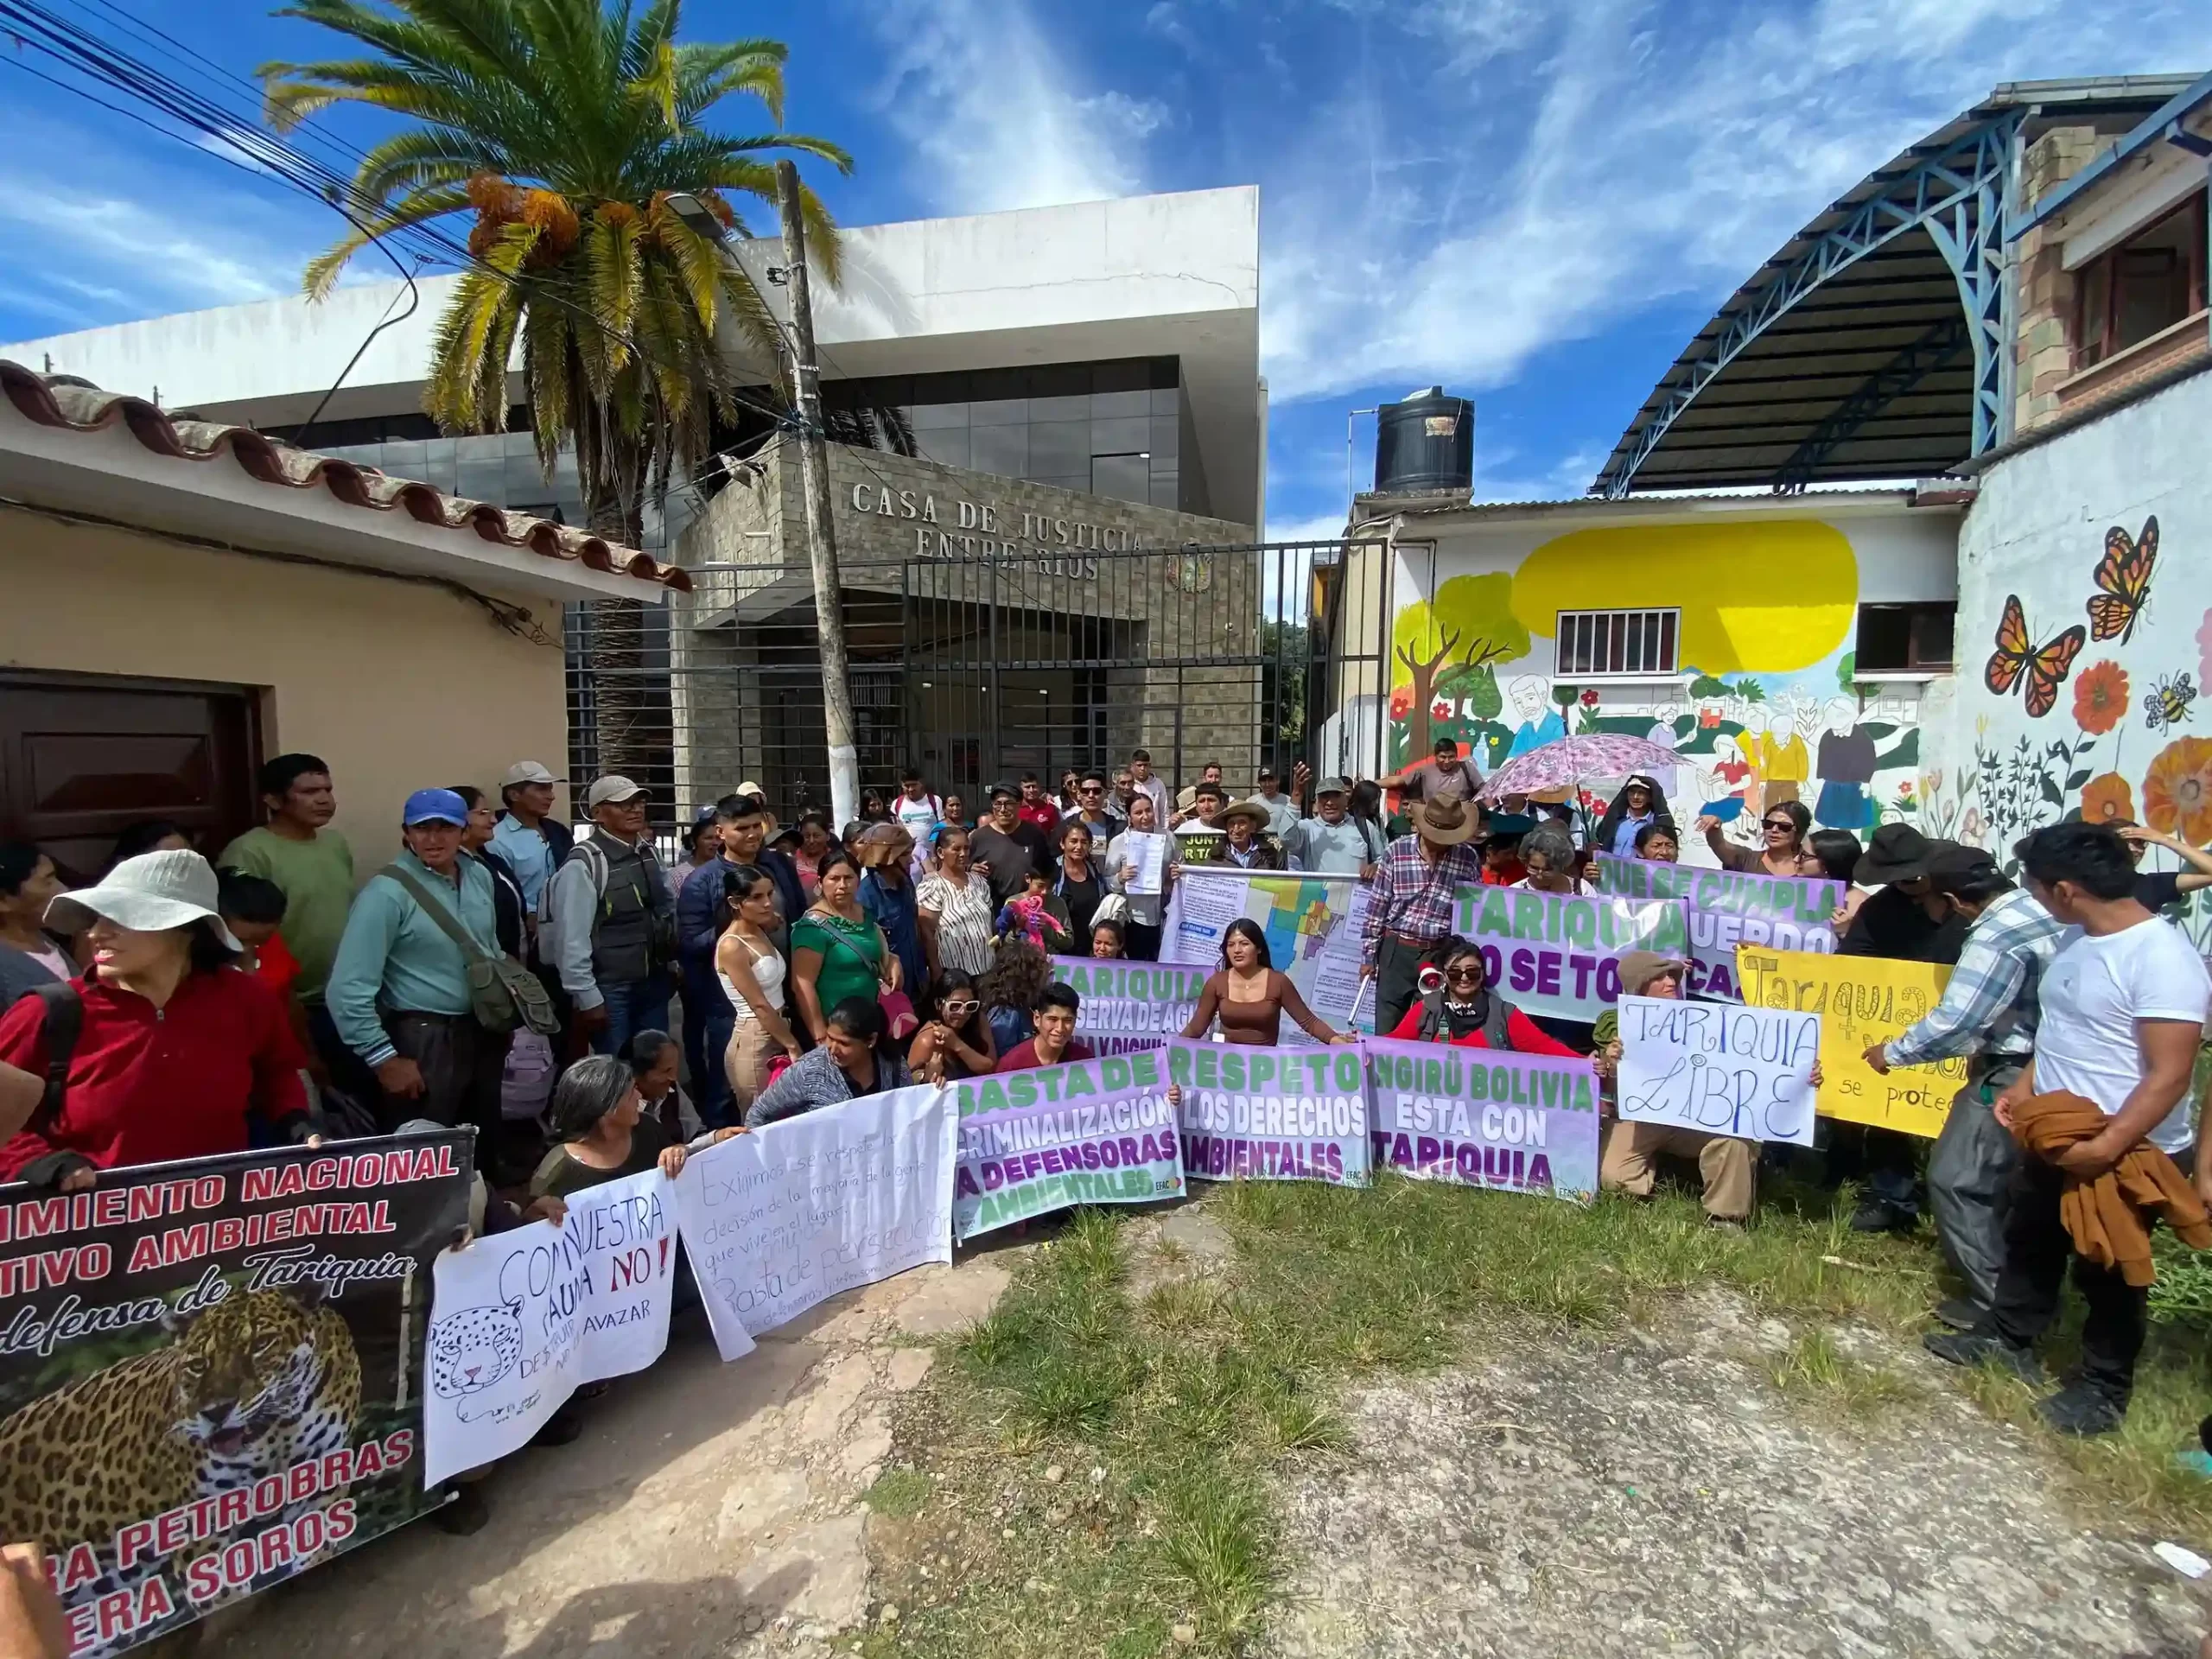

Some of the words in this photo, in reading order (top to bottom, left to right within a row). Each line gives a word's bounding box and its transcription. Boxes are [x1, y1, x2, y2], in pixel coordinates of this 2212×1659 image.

[853, 483, 938, 524] CASA
[957, 499, 997, 534] DE
[1018, 512, 1142, 552] JUSTICIA
[915, 528, 1018, 569] ENTRE
[1597, 857, 1647, 898] QUE
[1652, 867, 1694, 899] SE
[1696, 873, 1838, 923] CUMPLA
[1453, 885, 1687, 955] TARIQUIA
[1053, 964, 1205, 1002] TARIQUIA
[1510, 949, 1562, 996] SE
[1744, 955, 1927, 1028] Tariquia
[1136, 1002, 1162, 1032] DE
[1625, 1003, 1818, 1068] TARIQUIA
[1099, 1037, 1110, 1057] Y
[1170, 1046, 1361, 1094] RESPETO
[957, 1065, 1097, 1117] BASTA
[1101, 1052, 1159, 1094] DE
[1471, 1063, 1594, 1113] BOLIVIA
[1839, 1079, 1864, 1096] se
[1183, 1090, 1230, 1133] LOS
[1234, 1094, 1367, 1137] DERECHOS
[1395, 1094, 1471, 1136] ESTA
[1481, 1104, 1548, 1147] CON
[242, 1145, 459, 1202] NACIONAL
[700, 1158, 784, 1207] Exigimos
[797, 1154, 816, 1171] se
[825, 1137, 874, 1163] respete
[882, 1128, 896, 1147] la
[956, 1165, 980, 1199] A
[981, 1130, 1179, 1191] DEFENSORAS
[1155, 1179, 1170, 1191] EFAC
[1180, 1133, 1343, 1180] AMBIENTALES
[1370, 1130, 1554, 1186] TARIQUIA
[702, 1205, 764, 1245] decisión
[787, 1188, 801, 1203] la
[811, 1172, 860, 1196] mayoría
[866, 1166, 878, 1183] de
[881, 1165, 891, 1179] la
[894, 1159, 927, 1182] gente
[980, 1168, 1154, 1227] AMBIENTALES
[127, 1200, 396, 1274] AMBIENTAL
[704, 1246, 734, 1278] que
[772, 1224, 785, 1237] en
[789, 1212, 801, 1231] el
[785, 1244, 813, 1286] de
[175, 1264, 230, 1314] de
[243, 1244, 418, 1297] Tariquia
[583, 1300, 651, 1336] AVAZAR
[117, 1429, 414, 1571] PETROBRAS
[187, 1499, 357, 1605] SOROS
